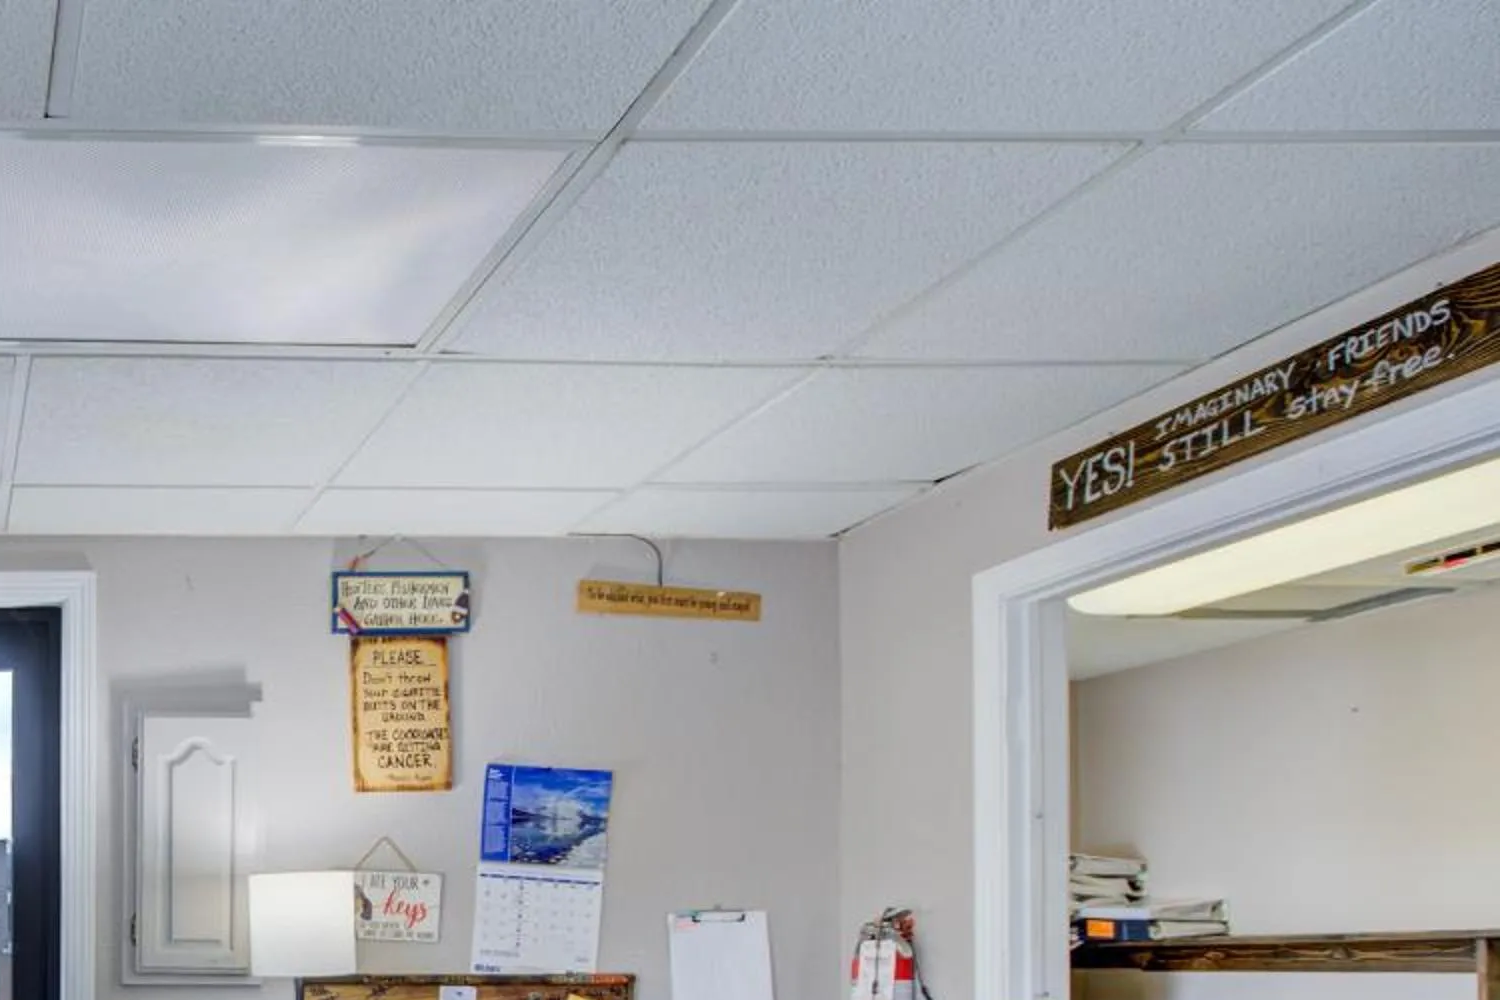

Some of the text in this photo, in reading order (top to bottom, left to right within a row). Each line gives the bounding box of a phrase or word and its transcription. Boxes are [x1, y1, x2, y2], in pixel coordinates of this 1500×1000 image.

[1153, 299, 1451, 441] IMAGINARY FRIENDS
[1059, 441, 1136, 510] YES!
[1158, 410, 1267, 472] STILL
